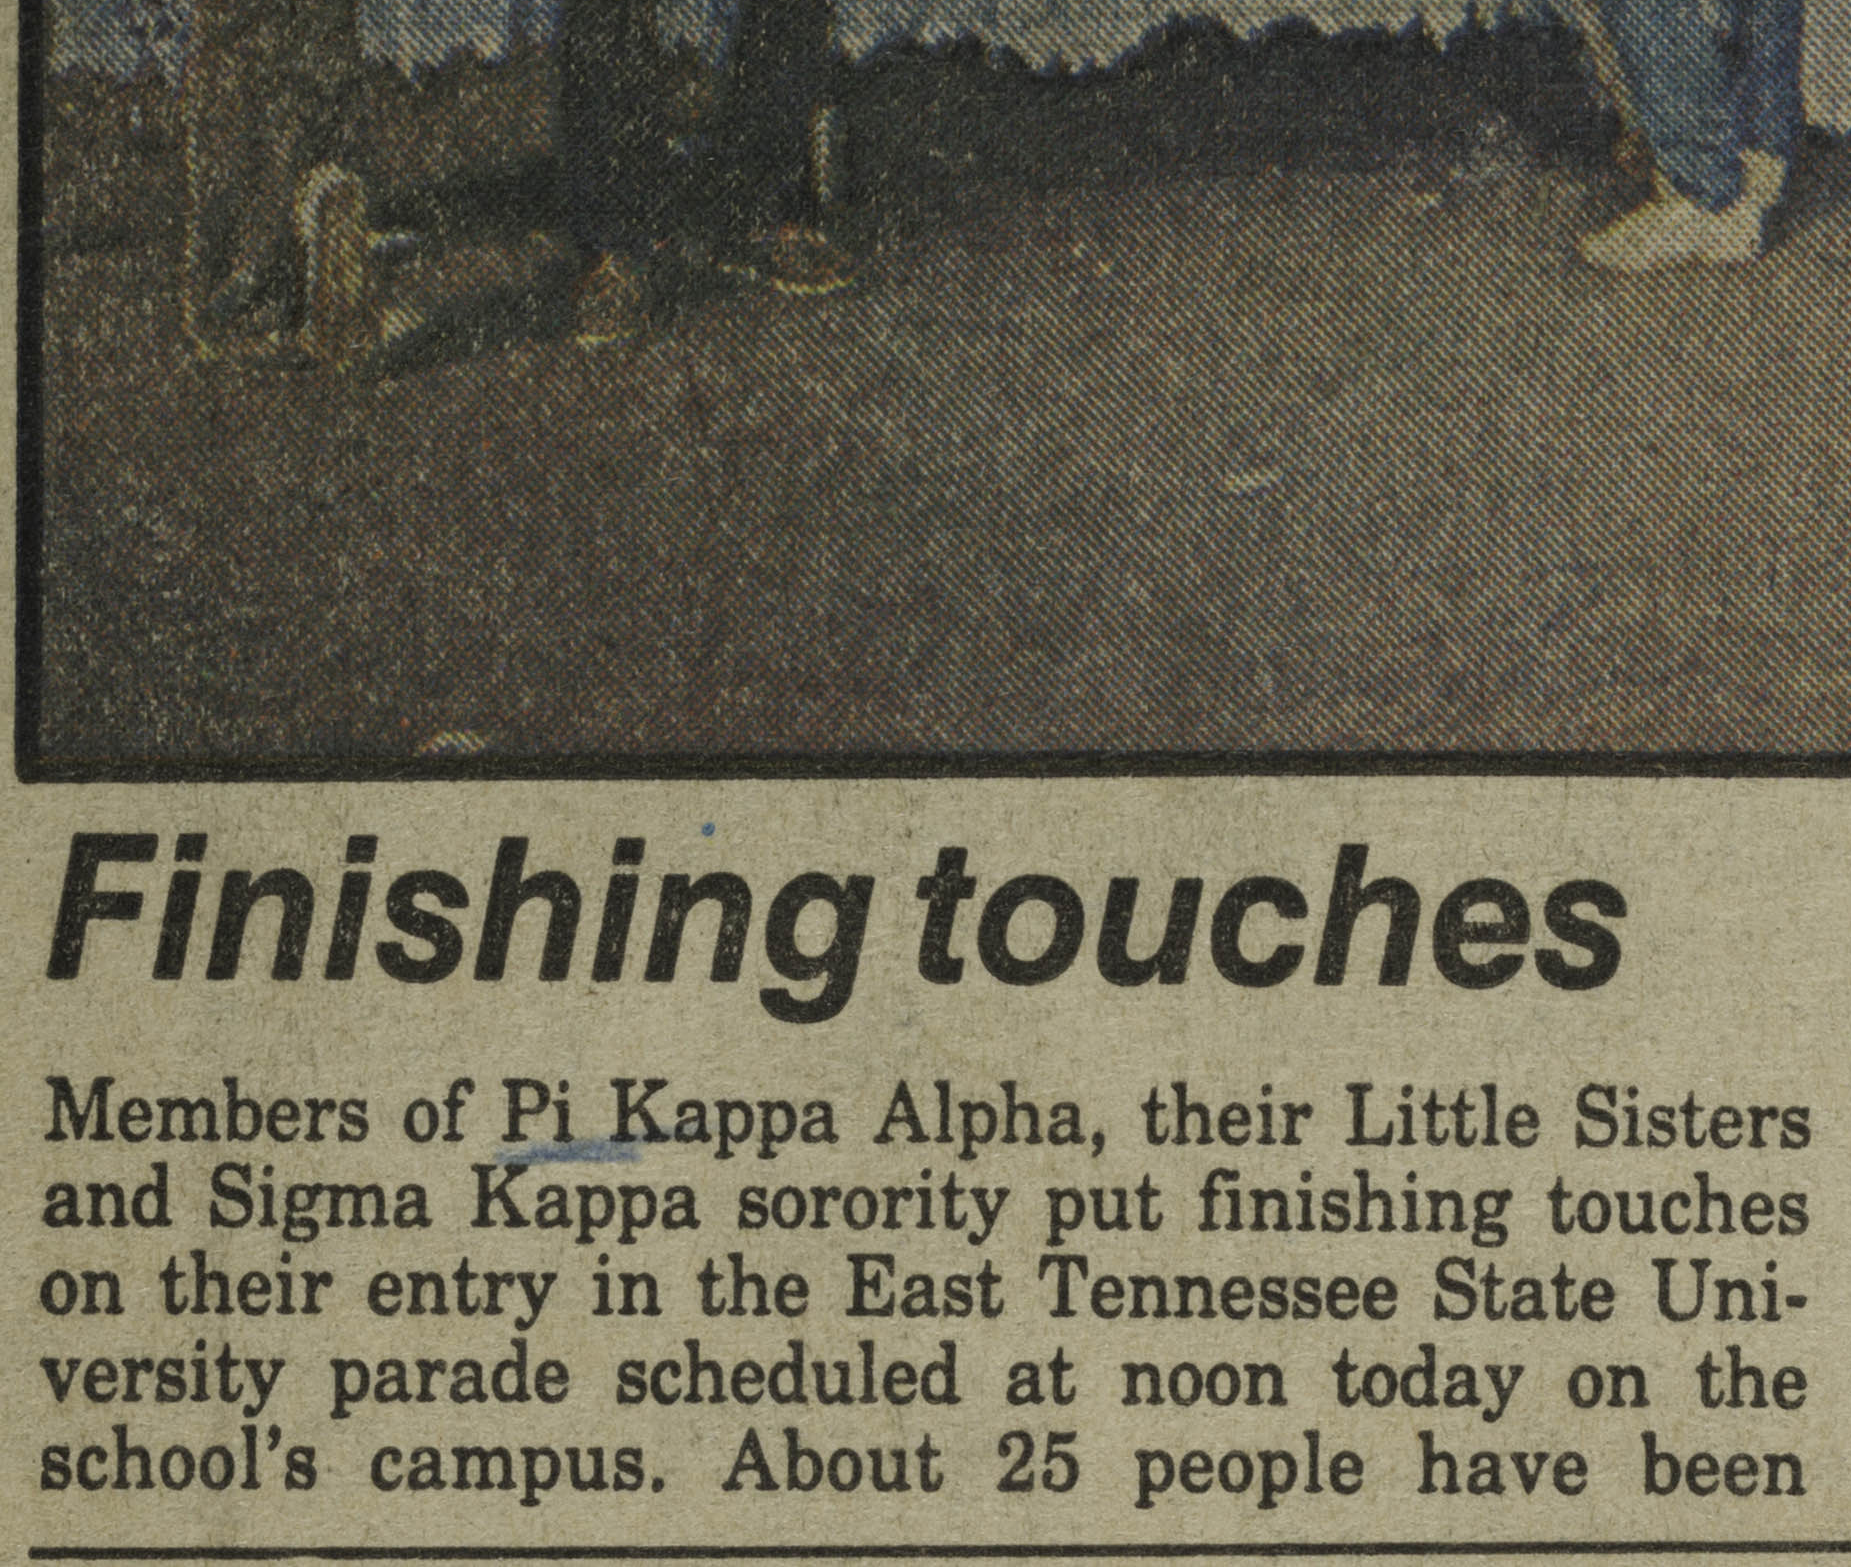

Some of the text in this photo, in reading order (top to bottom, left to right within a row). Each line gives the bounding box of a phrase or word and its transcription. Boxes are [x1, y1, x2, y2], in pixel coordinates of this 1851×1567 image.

[46, 832, 1627, 1024] Finishing touches
[44, 1076, 1810, 1161] Members of Pi Kappa Alpha, their Little Sisters
[42, 1161, 1808, 1248] and Sigma Kappa sorority put finishing touches
[39, 1249, 1807, 1331] on their entry in the East Tennessee State Uni-
[39, 1338, 1807, 1423] versity parade scheduled at noon today on the
[40, 1424, 1805, 1510] school's campus. About 25 people have been
